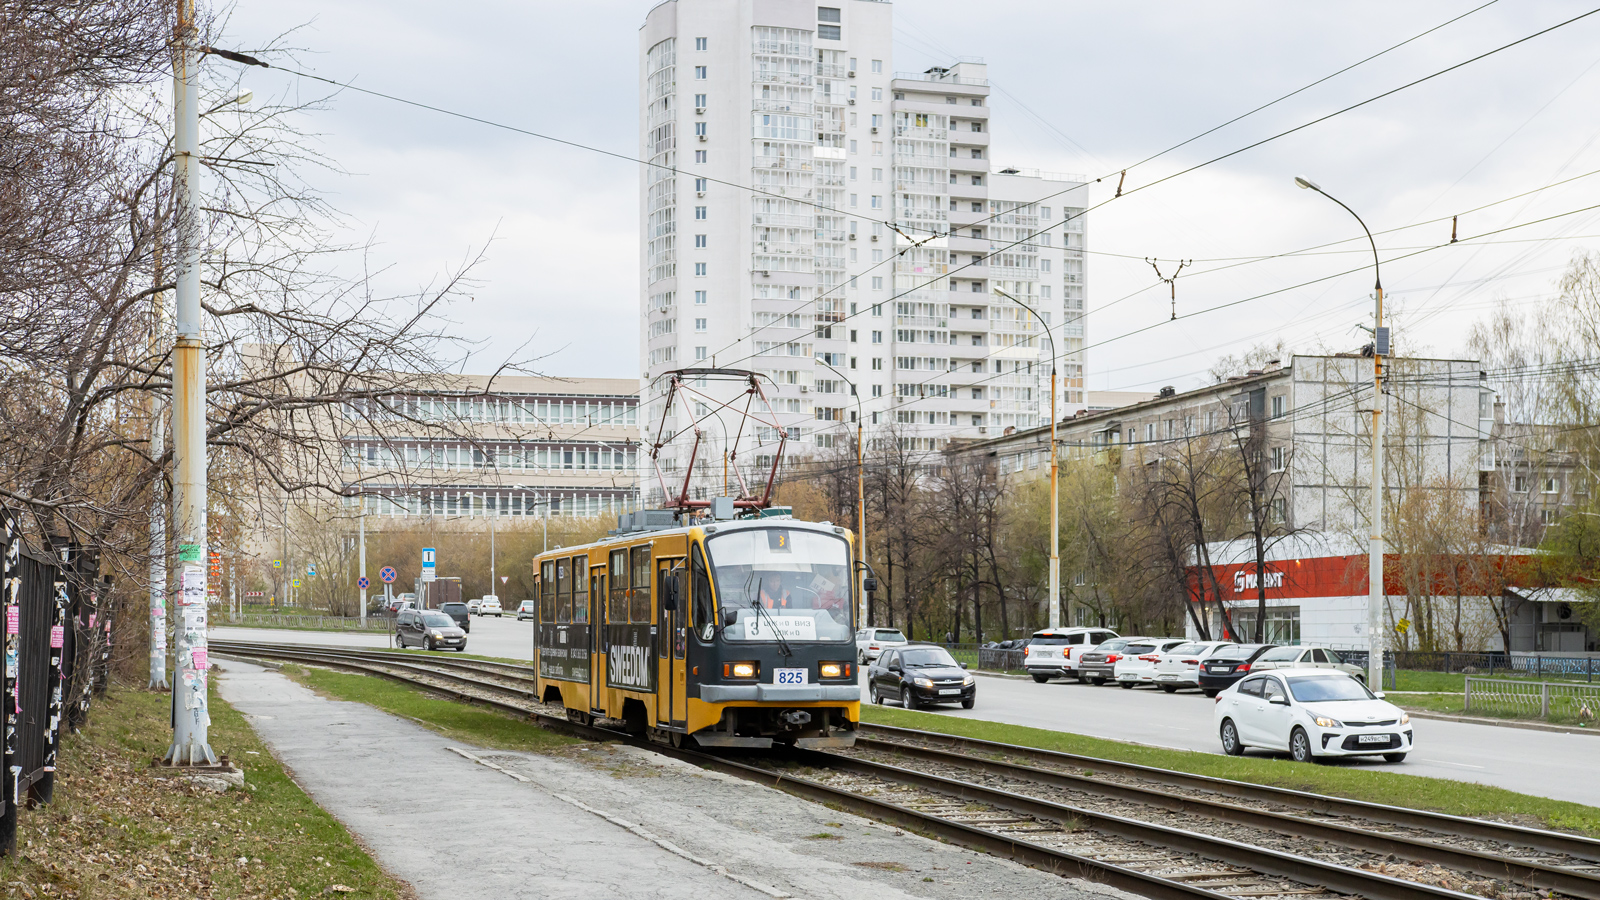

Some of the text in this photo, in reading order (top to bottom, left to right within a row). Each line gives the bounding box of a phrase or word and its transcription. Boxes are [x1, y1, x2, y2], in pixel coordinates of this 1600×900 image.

[779, 535, 785, 547] 3
[1246, 572, 1284, 589] МАНИТ
[750, 622, 759, 636] 3
[610, 644, 648, 687] SWEEDOM
[779, 672, 803, 684] 825
